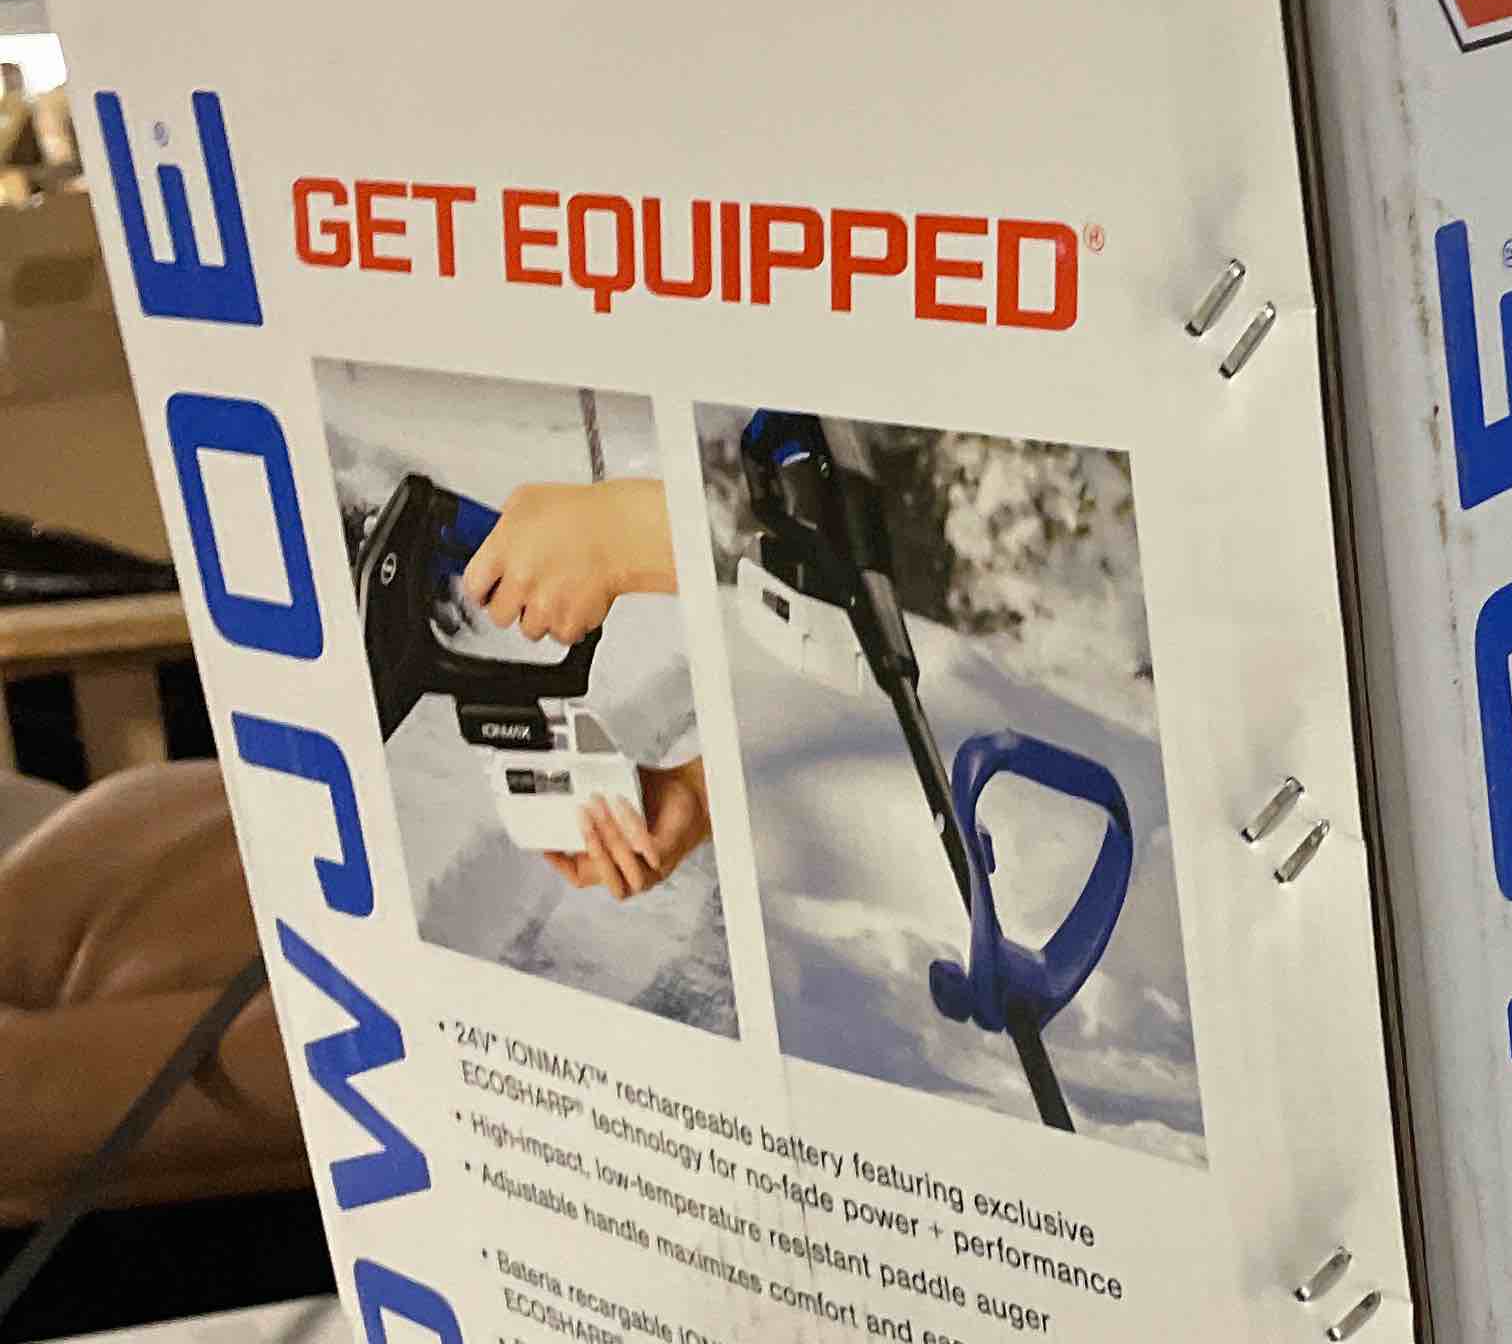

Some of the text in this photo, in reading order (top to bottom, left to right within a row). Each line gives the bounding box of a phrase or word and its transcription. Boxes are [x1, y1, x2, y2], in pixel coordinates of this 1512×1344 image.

[291, 175, 477, 278] GET
[470, 1110, 1051, 1334] High-impact, low-temperature resistant paddle auger
[481, 1162, 579, 1222] Adjustable
[582, 1202, 652, 1250] handle
[656, 1233, 764, 1296] maximizes
[768, 1278, 859, 1329] comfort
[865, 1312, 914, 1344] and
[591, 1107, 703, 1172] technology
[708, 1148, 739, 1183] for
[745, 1165, 835, 1214] no-fade
[842, 1196, 921, 1239] power
[927, 1219, 945, 1240] +
[952, 1227, 1124, 1300] performance
[615, 1078, 753, 1147] rechargeable
[759, 1123, 844, 1178] battery
[851, 1151, 966, 1215] featuring
[973, 1190, 1096, 1249] exclusive
